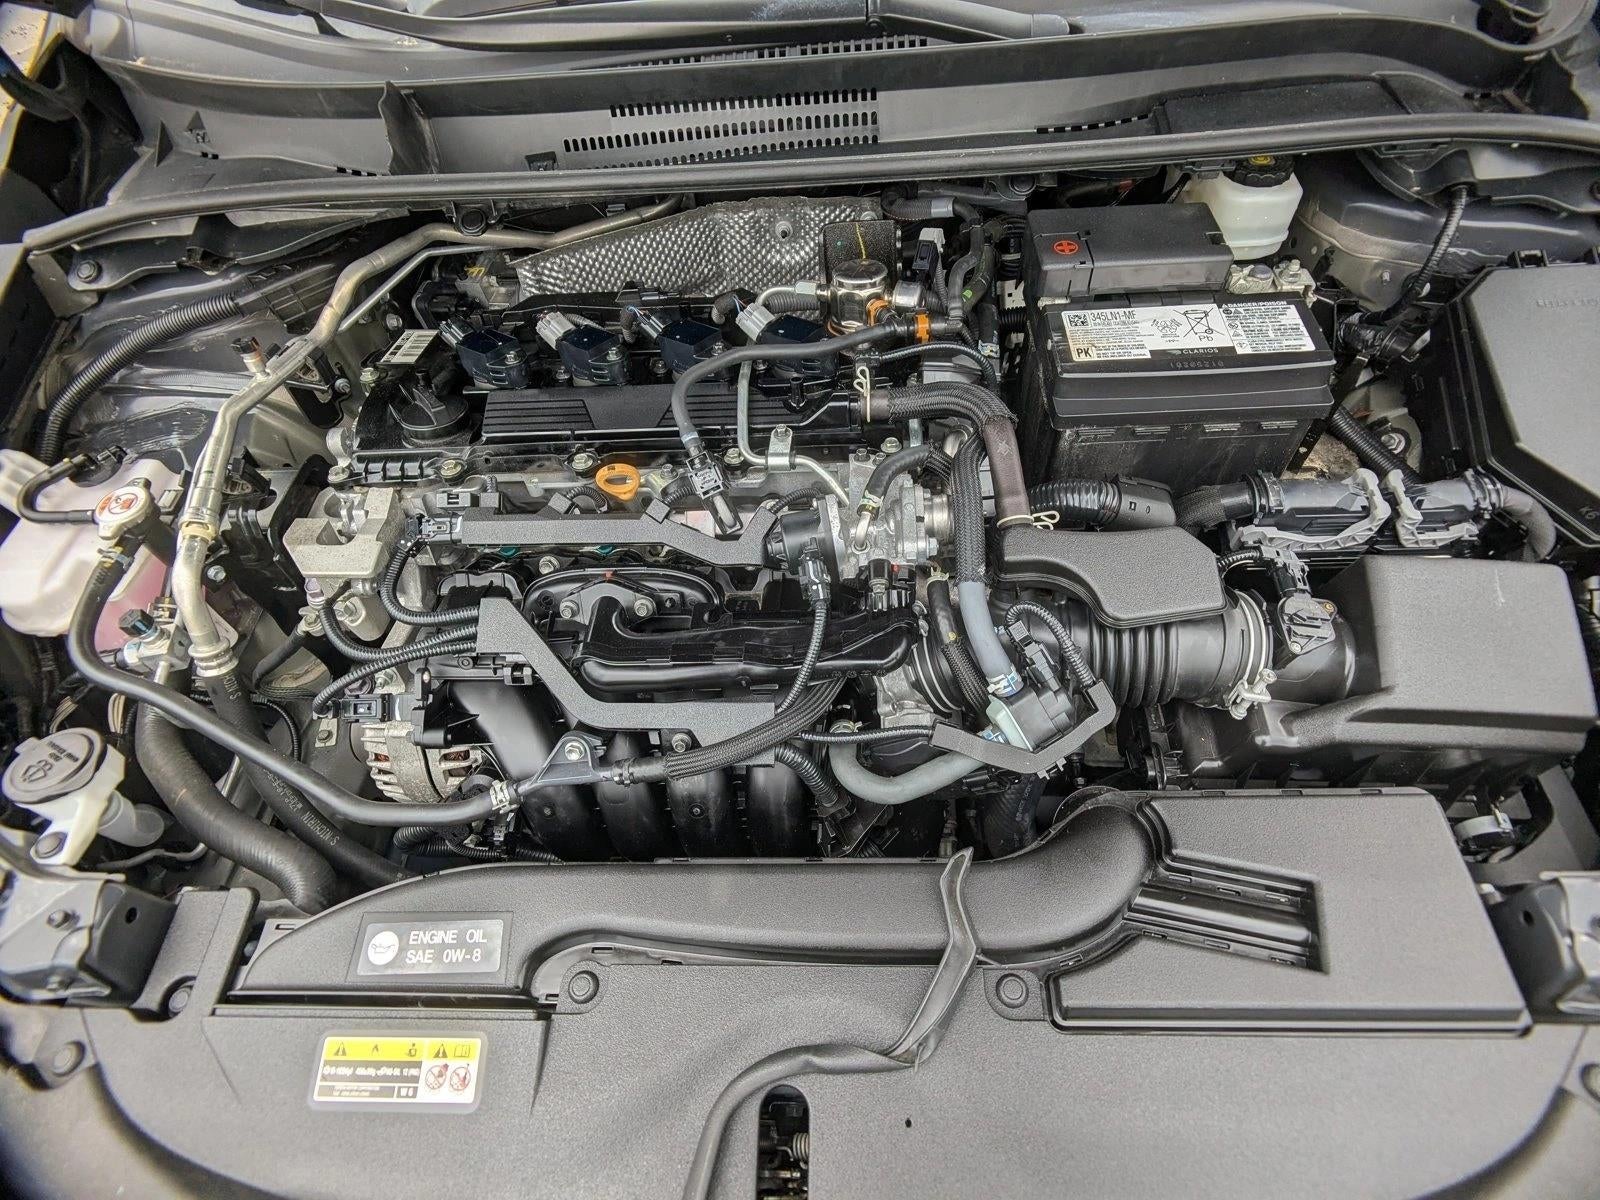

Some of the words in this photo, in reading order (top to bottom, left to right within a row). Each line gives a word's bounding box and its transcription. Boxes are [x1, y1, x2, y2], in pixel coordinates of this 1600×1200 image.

[1090, 310, 1136, 321] 345LN1-MF
[1076, 347, 1092, 358] PK
[408, 929, 458, 945] ENGINE
[466, 928, 488, 943] OIL
[405, 949, 434, 964] SAE
[443, 948, 481, 963] 0W-8
